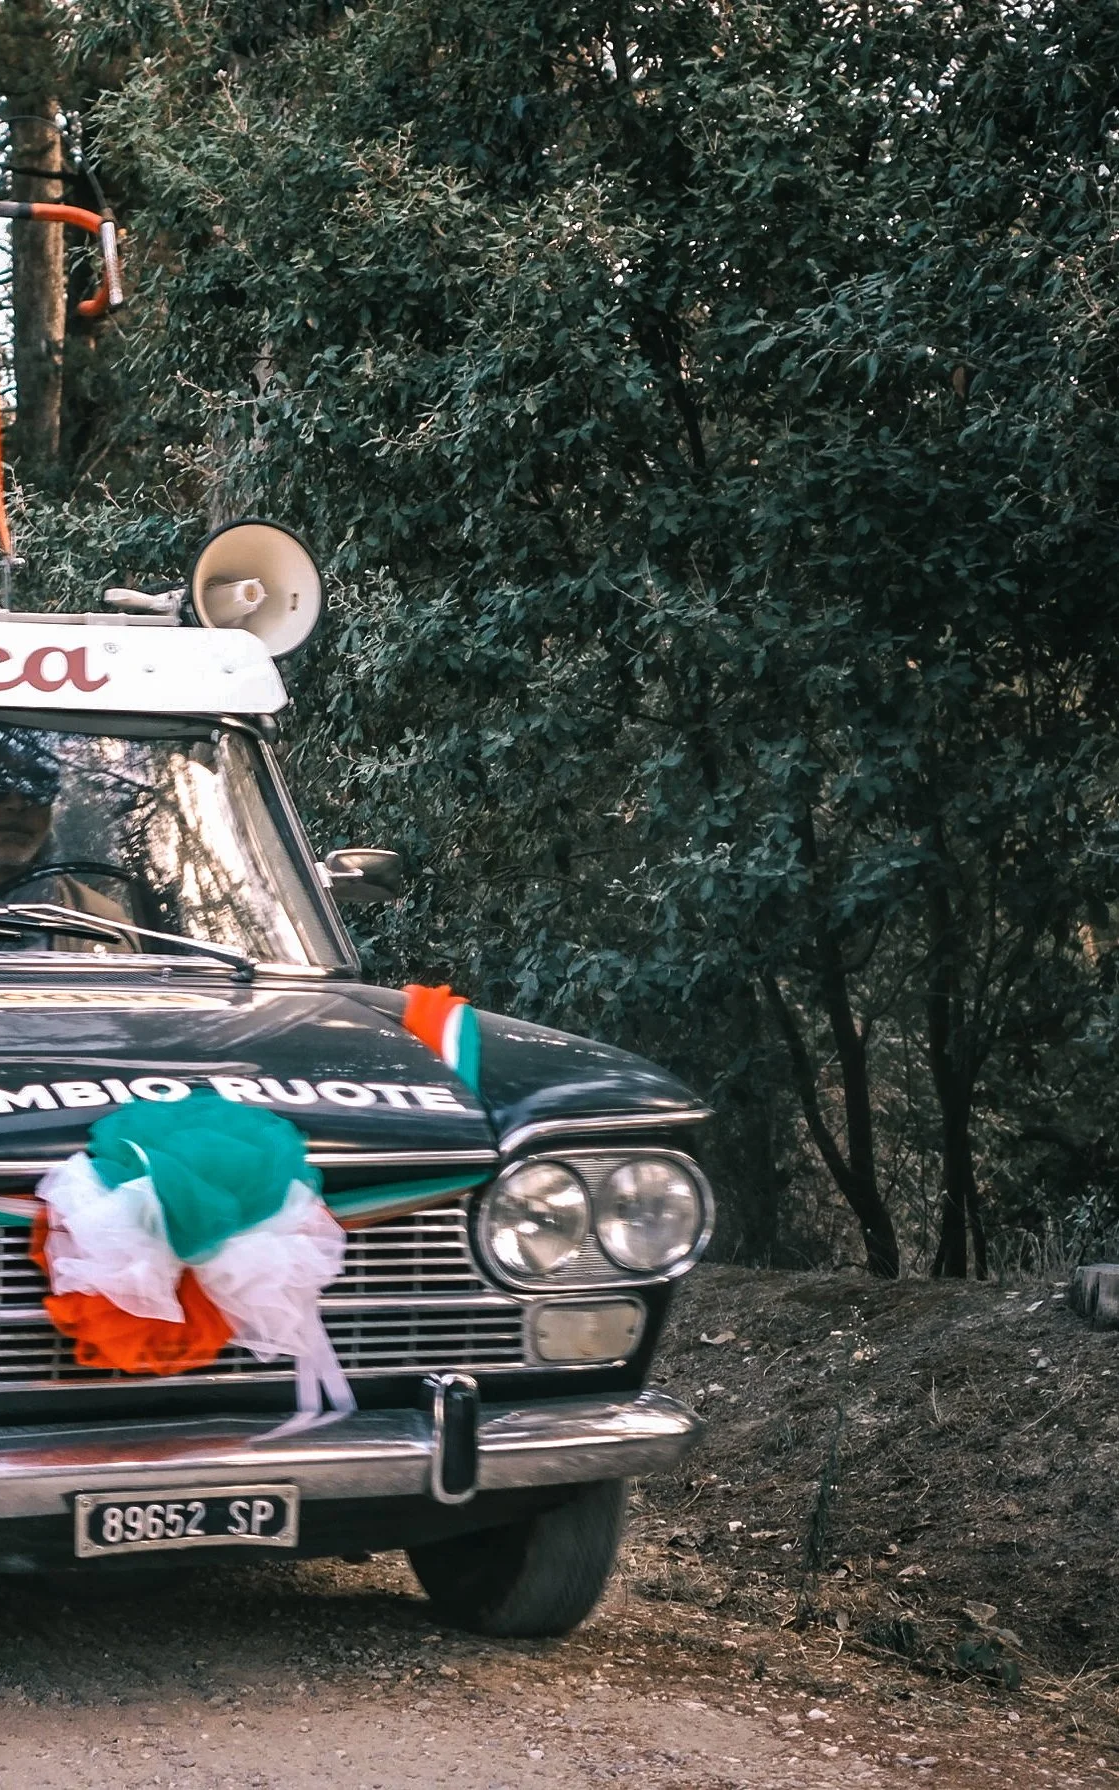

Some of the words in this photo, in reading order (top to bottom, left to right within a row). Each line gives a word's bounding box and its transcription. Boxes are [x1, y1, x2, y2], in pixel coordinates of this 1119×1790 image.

[208, 1075, 468, 1112] RUOTE
[102, 1501, 206, 1543] 89652
[227, 1500, 275, 1536] SP
